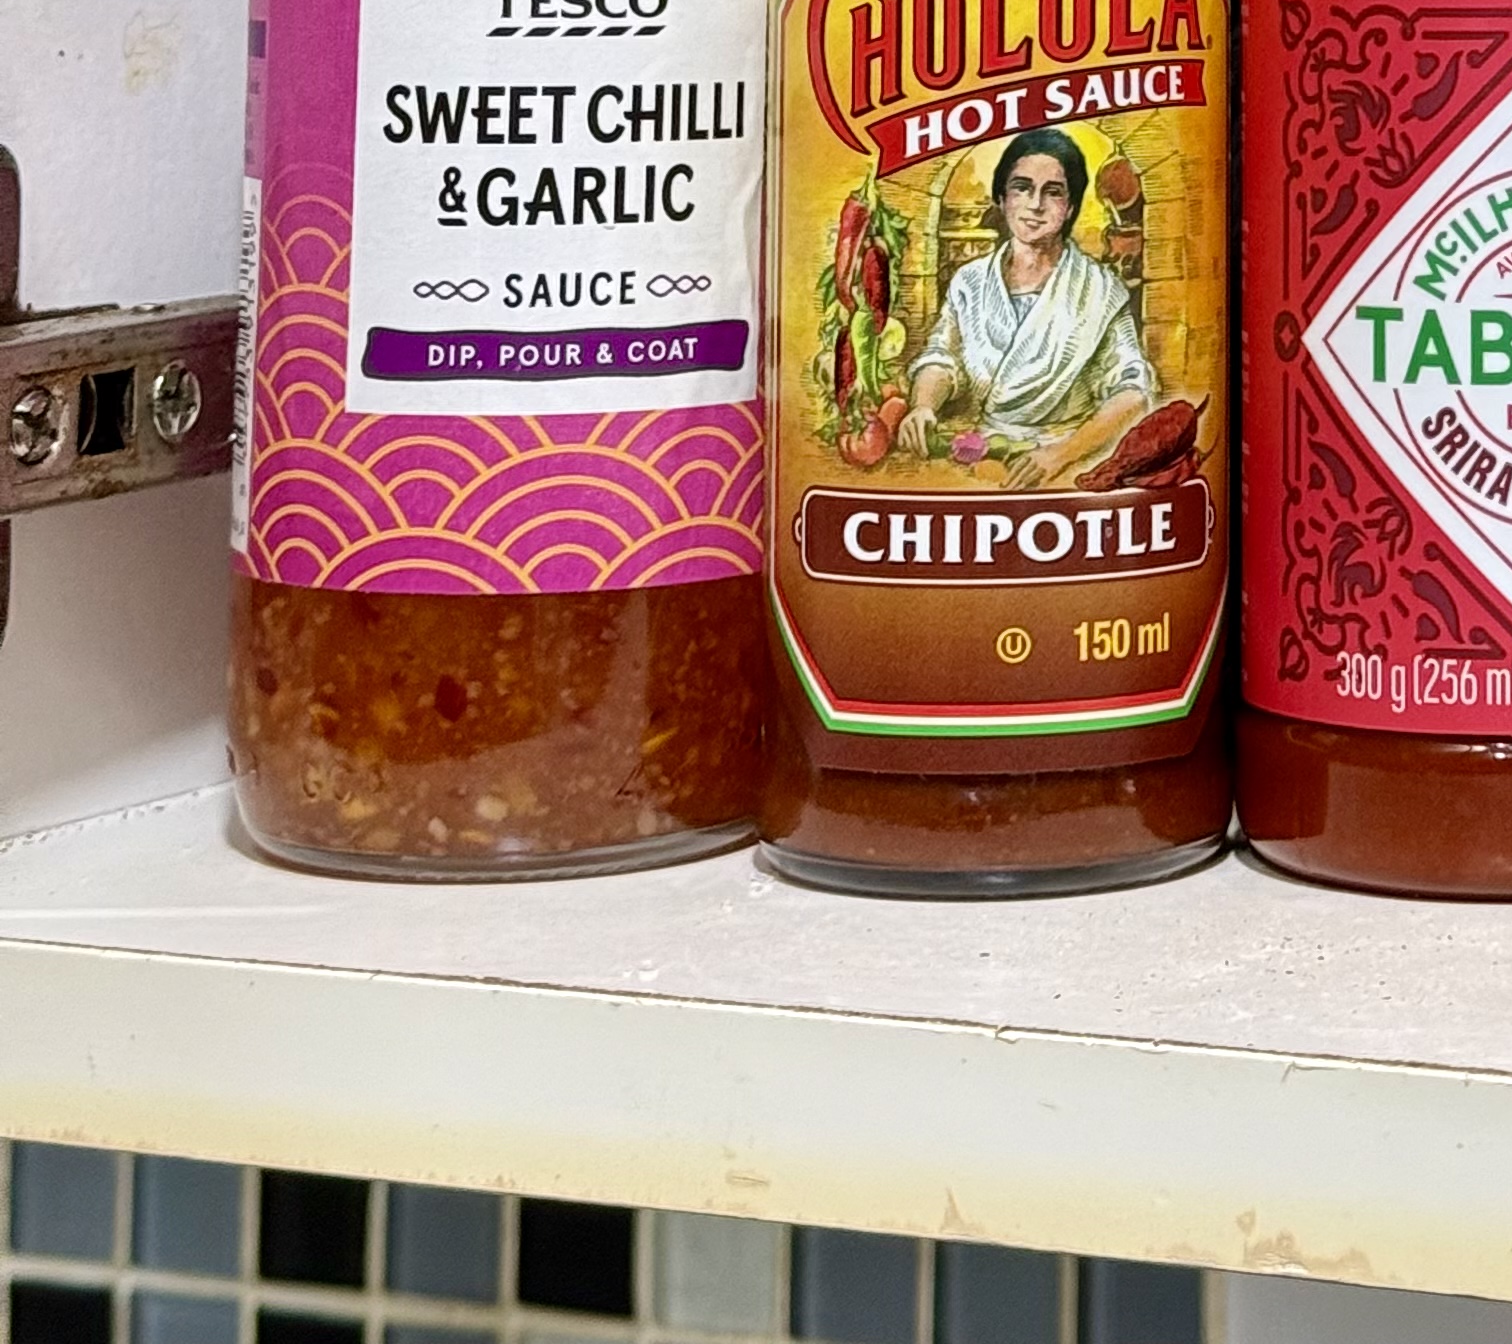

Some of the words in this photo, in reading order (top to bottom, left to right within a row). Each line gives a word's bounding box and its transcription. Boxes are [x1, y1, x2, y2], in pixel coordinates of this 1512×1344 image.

[383, 84, 577, 144] SWEET
[587, 81, 746, 143] CHILLI
[903, 88, 1028, 159] HOT
[1045, 64, 1186, 122] SAUCE
[503, 271, 636, 308] SAUCE
[428, 344, 483, 369] DIP,
[499, 344, 582, 367] POUR
[596, 343, 614, 364] &
[627, 338, 698, 363] COAT
[843, 502, 1177, 563] CHIPOTLE
[1073, 618, 1131, 661] 150
[1138, 612, 1170, 656] ml
[1336, 651, 1383, 700] 300
[1390, 662, 1407, 712] g
[1414, 655, 1479, 706] (256
